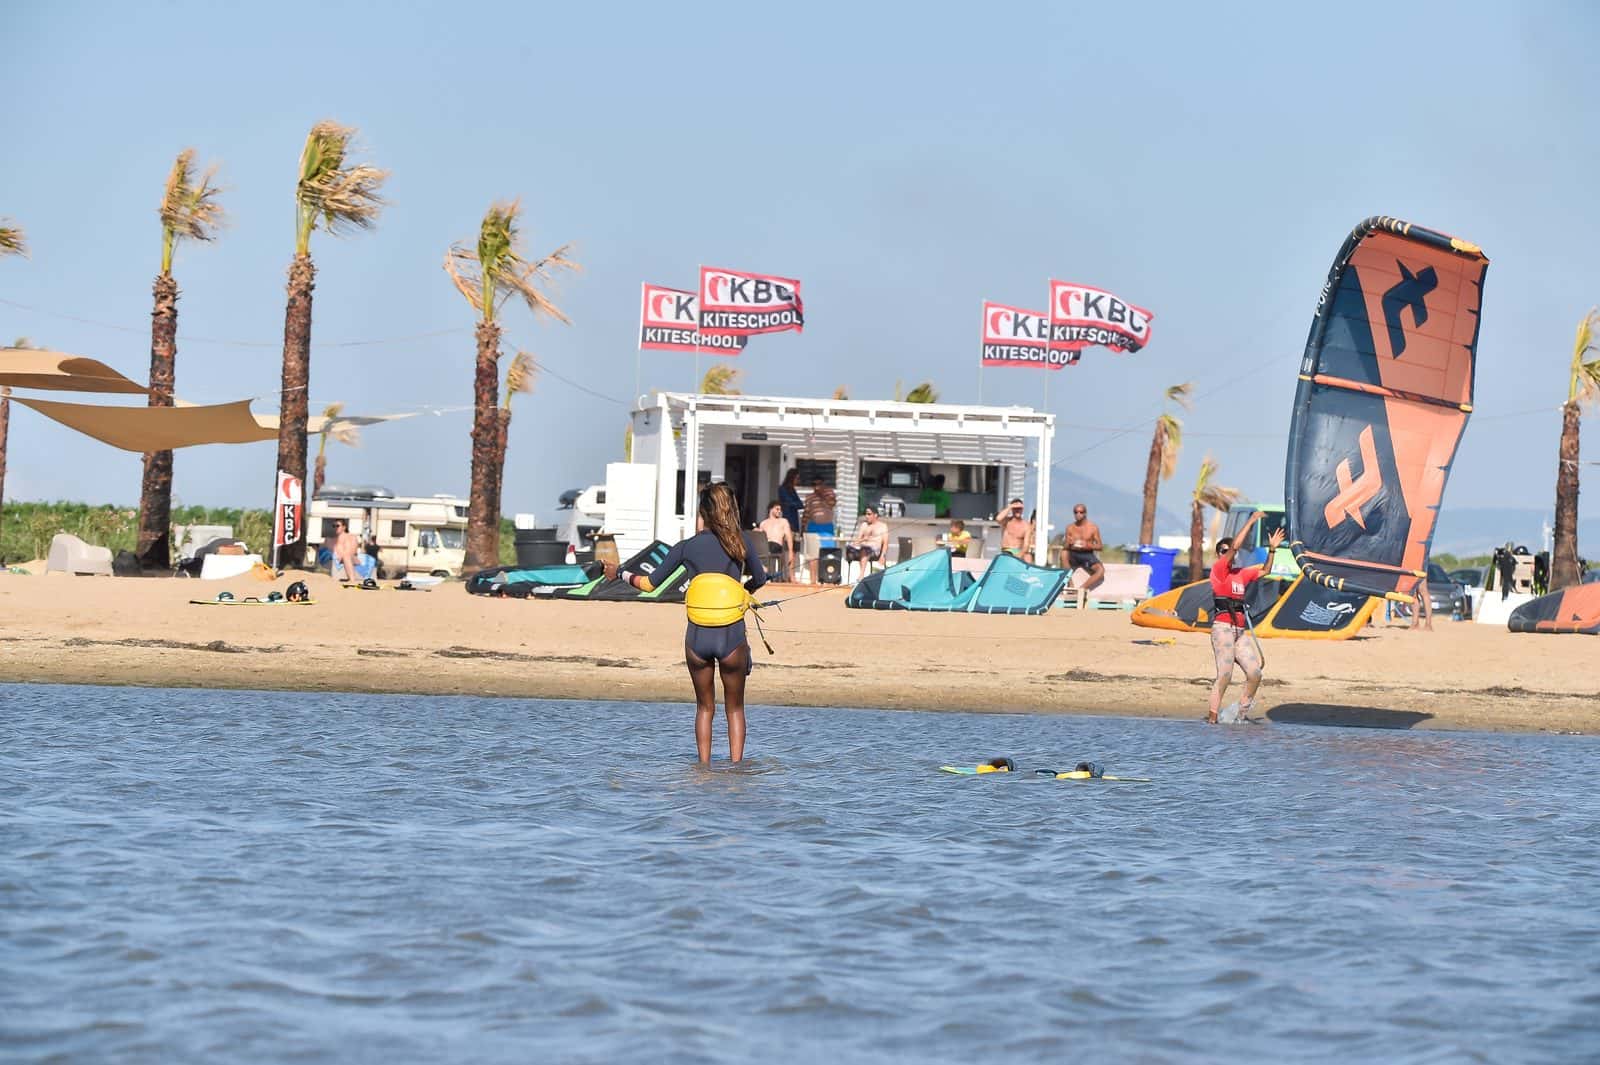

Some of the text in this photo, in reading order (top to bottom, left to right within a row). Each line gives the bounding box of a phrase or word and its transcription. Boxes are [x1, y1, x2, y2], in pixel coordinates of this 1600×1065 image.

[703, 310, 801, 328] KITESCHOOL
[645, 328, 742, 349] KITESCHOOL
[284, 505, 294, 544] KBC
